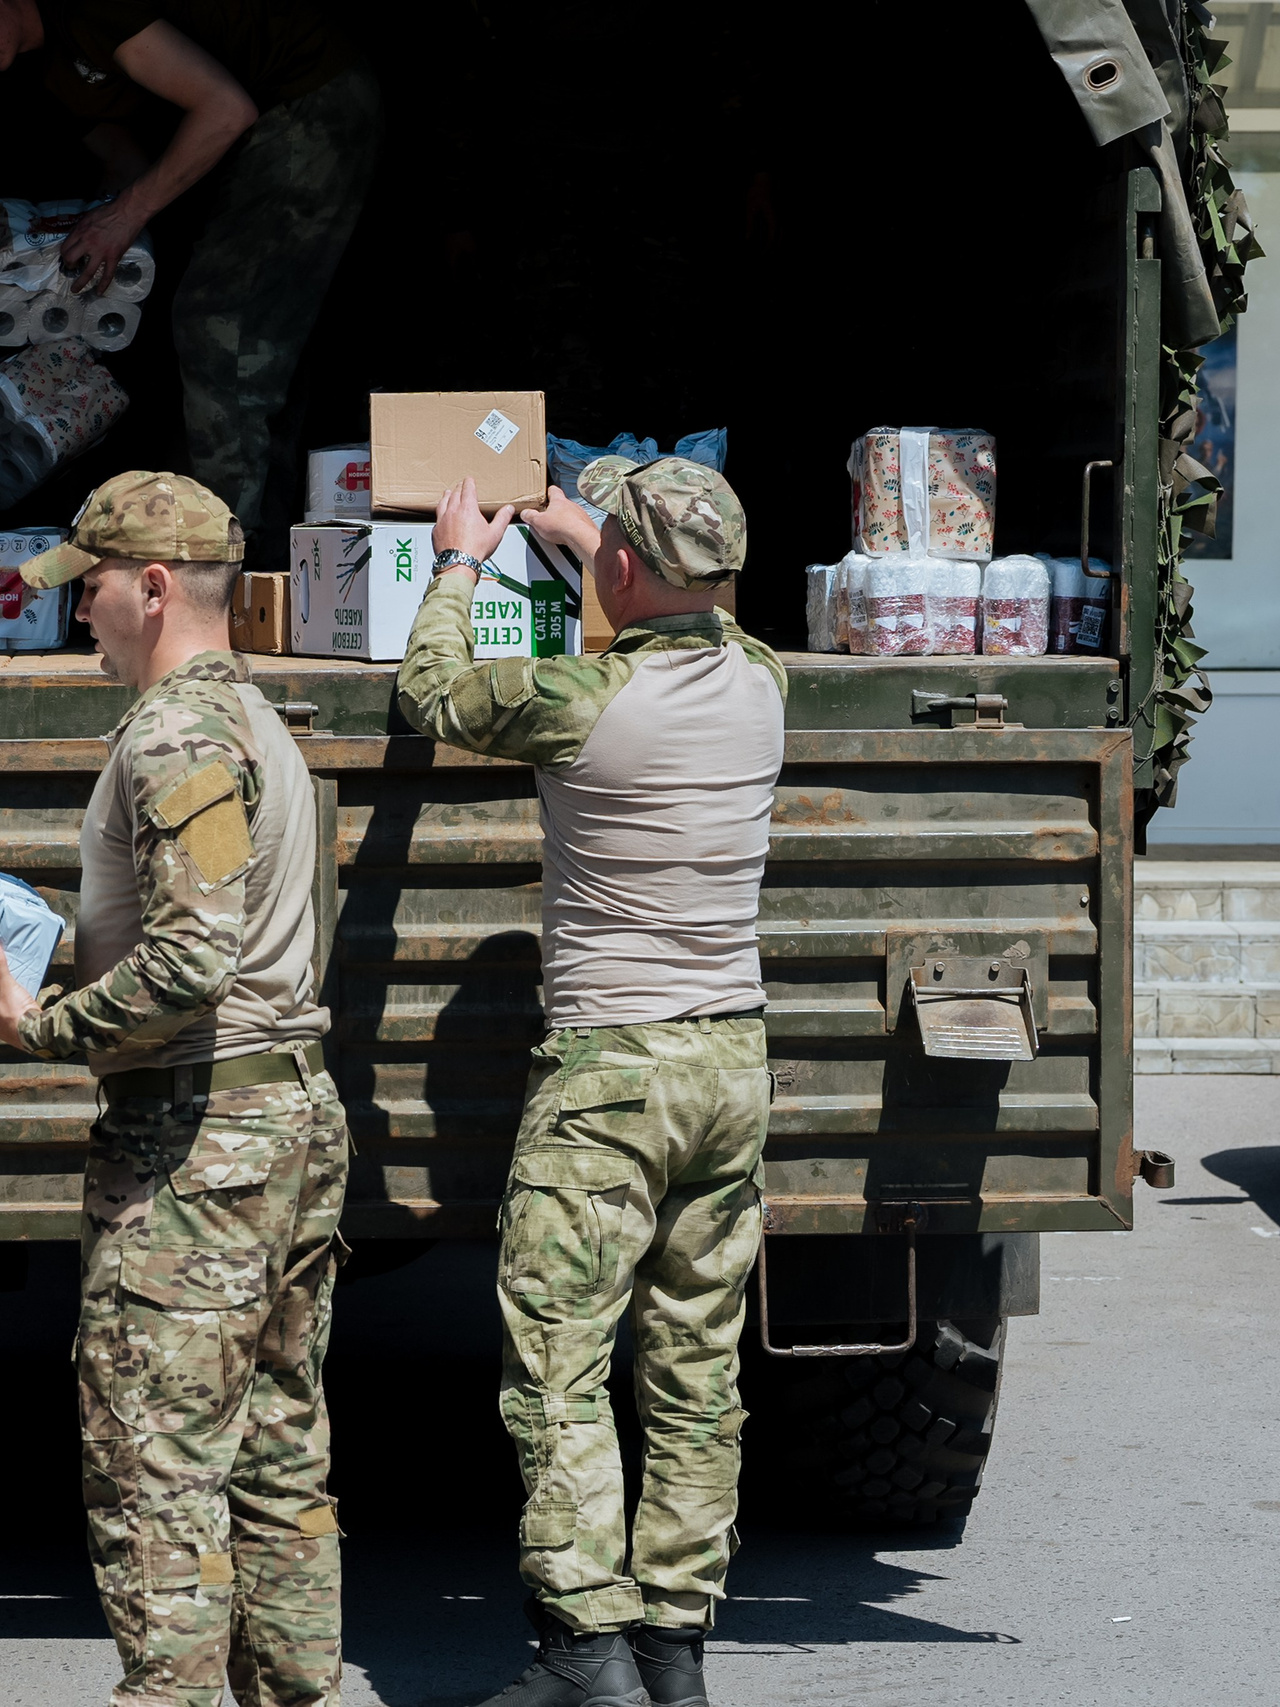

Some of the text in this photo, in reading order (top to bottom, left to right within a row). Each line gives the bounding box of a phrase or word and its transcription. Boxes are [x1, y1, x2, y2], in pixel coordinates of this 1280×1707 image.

[312, 538, 321, 581] ZDK
[396, 538, 412, 582] ZDK
[334, 608, 363, 626] КАБЕЛЬ
[472, 601, 522, 619] КАБЕ
[550, 616, 562, 639] 305
[332, 632, 363, 653] СЕТЕВОЙ
